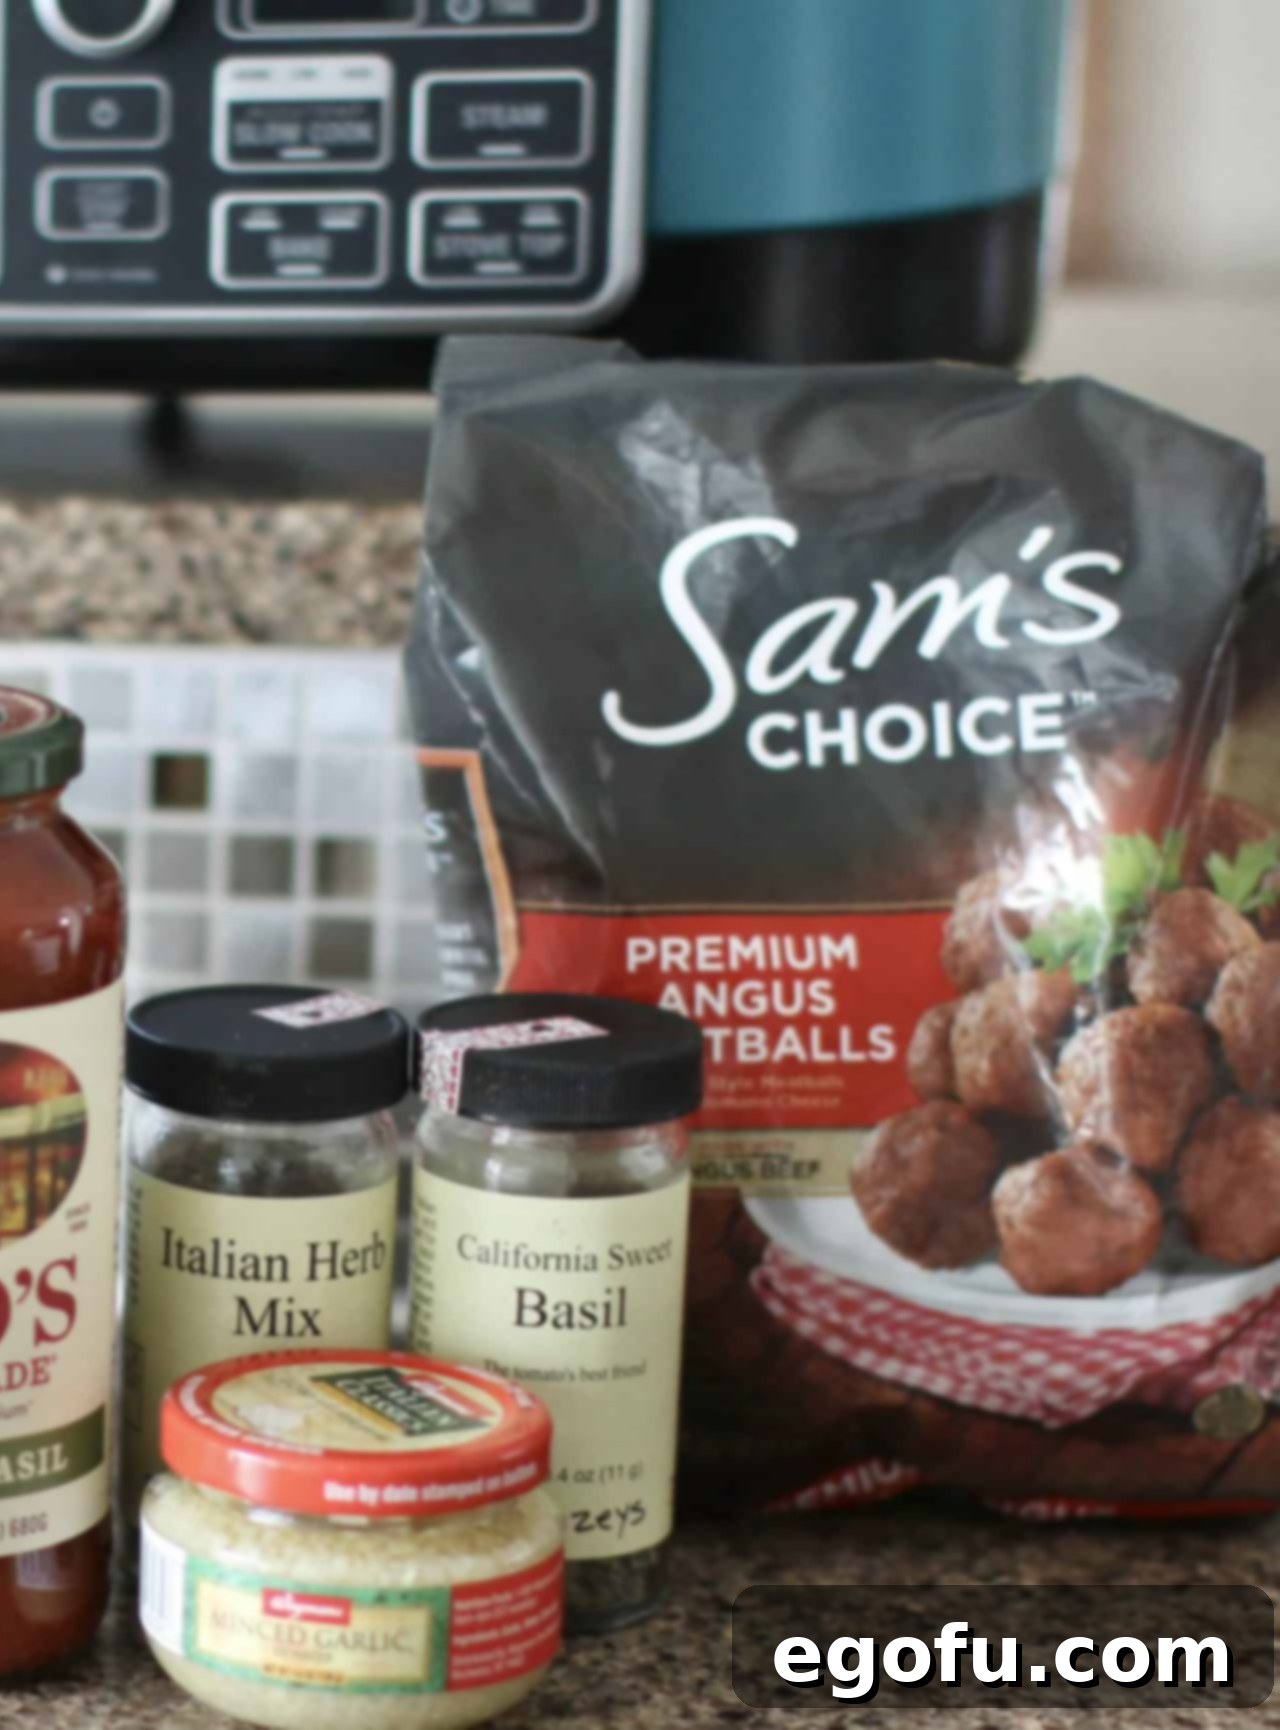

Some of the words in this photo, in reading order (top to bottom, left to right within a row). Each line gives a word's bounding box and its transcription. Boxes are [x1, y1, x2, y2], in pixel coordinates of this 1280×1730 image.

[308, 120, 374, 145] COOK
[460, 104, 549, 130] STEAM
[518, 233, 568, 257] TOP
[601, 516, 1124, 747] Sam's
[745, 690, 1067, 770] CHOICE
[626, 933, 860, 974] PREMIUM
[657, 979, 837, 1019] ANGUS
[703, 1024, 898, 1066] TBALLS
[691, 1158, 753, 1182] NGUS
[159, 1226, 290, 1284] Italian
[305, 1227, 388, 1283] Herb
[455, 1232, 599, 1273] California
[232, 1294, 325, 1339] Mix
[513, 1285, 628, 1331] Basil
[322, 1479, 356, 1501] Use
[357, 1482, 380, 1508] by
[381, 1483, 419, 1503] date
[573, 1469, 596, 1485] oz
[570, 1499, 647, 1540] zeys
[313, 1625, 411, 1654] GARLIC
